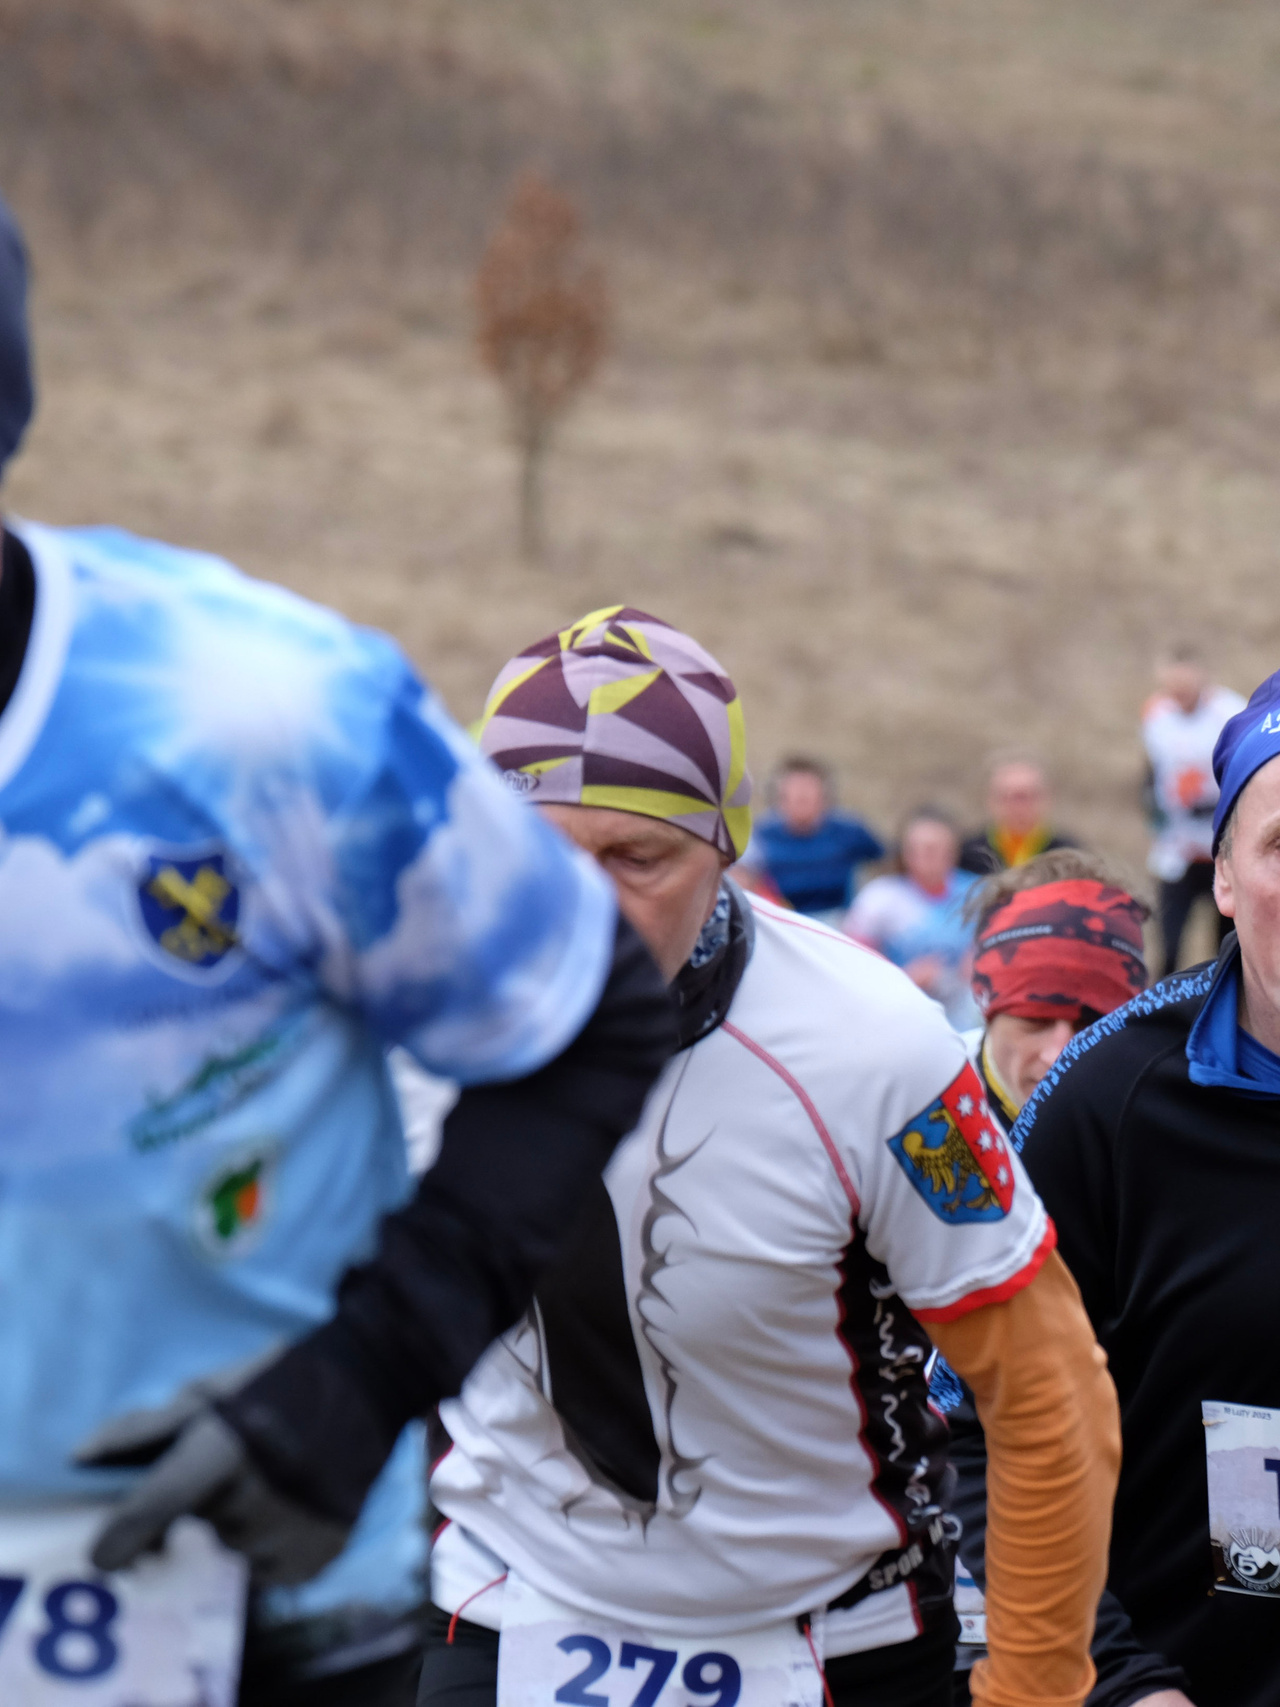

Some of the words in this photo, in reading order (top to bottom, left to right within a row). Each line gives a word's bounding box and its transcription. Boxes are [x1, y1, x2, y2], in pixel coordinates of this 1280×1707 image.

[1232, 1408, 1250, 1418] LUTY
[1252, 1411, 1272, 1421] 2023
[555, 1633, 742, 1707] 279
